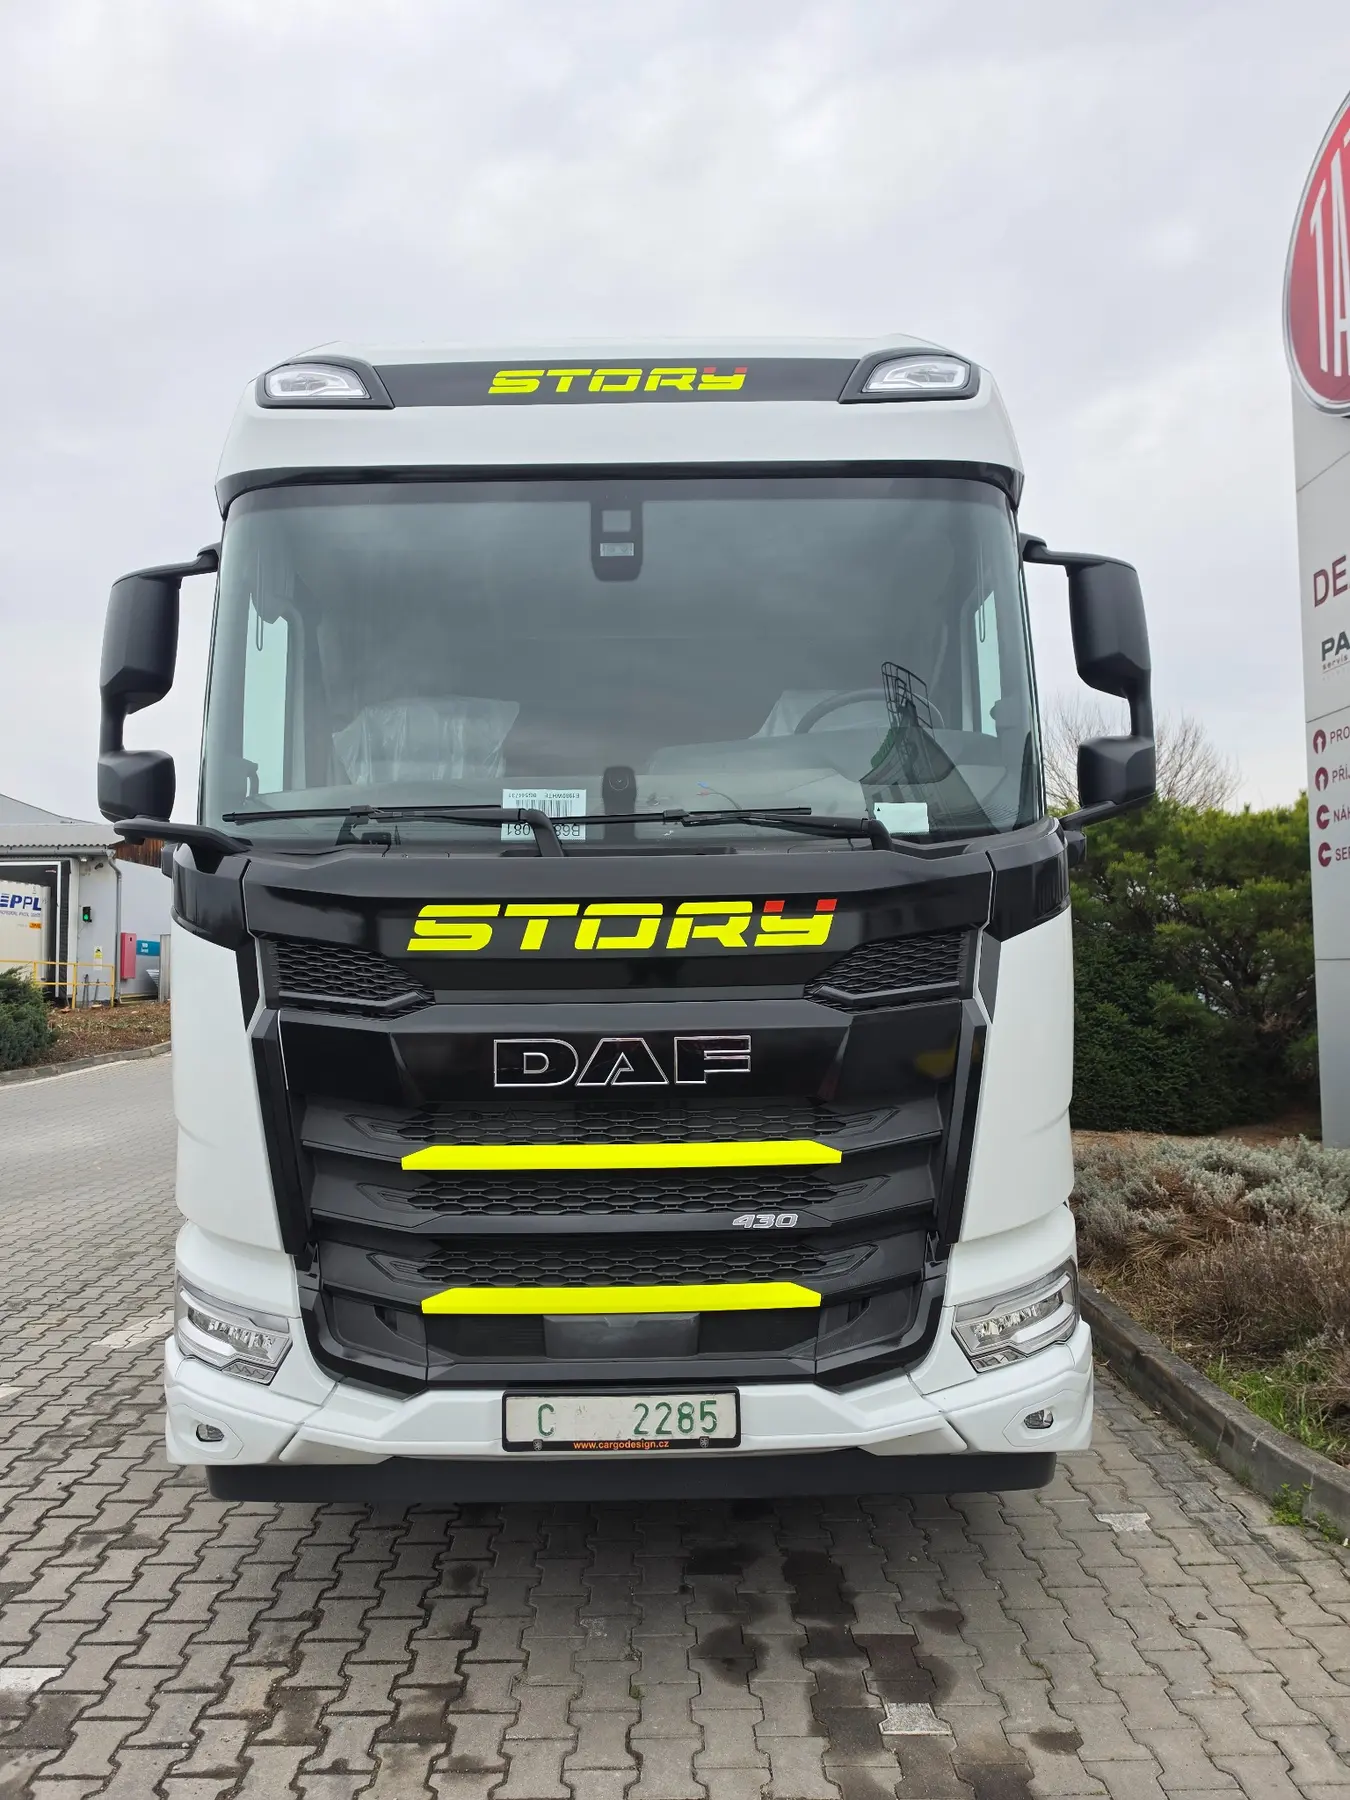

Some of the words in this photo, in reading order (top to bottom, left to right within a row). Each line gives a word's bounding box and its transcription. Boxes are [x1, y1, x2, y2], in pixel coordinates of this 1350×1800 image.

[1310, 128, 1350, 377] TA
[488, 367, 748, 394] STORY
[1313, 555, 1350, 608] DE
[407, 898, 838, 951] STORY
[493, 1035, 751, 1087] DAF
[732, 1213, 799, 1229] 430
[537, 1403, 555, 1436] C
[633, 1400, 718, 1435] 2285
[573, 1440, 670, 1450] www.cargodesign.cz
